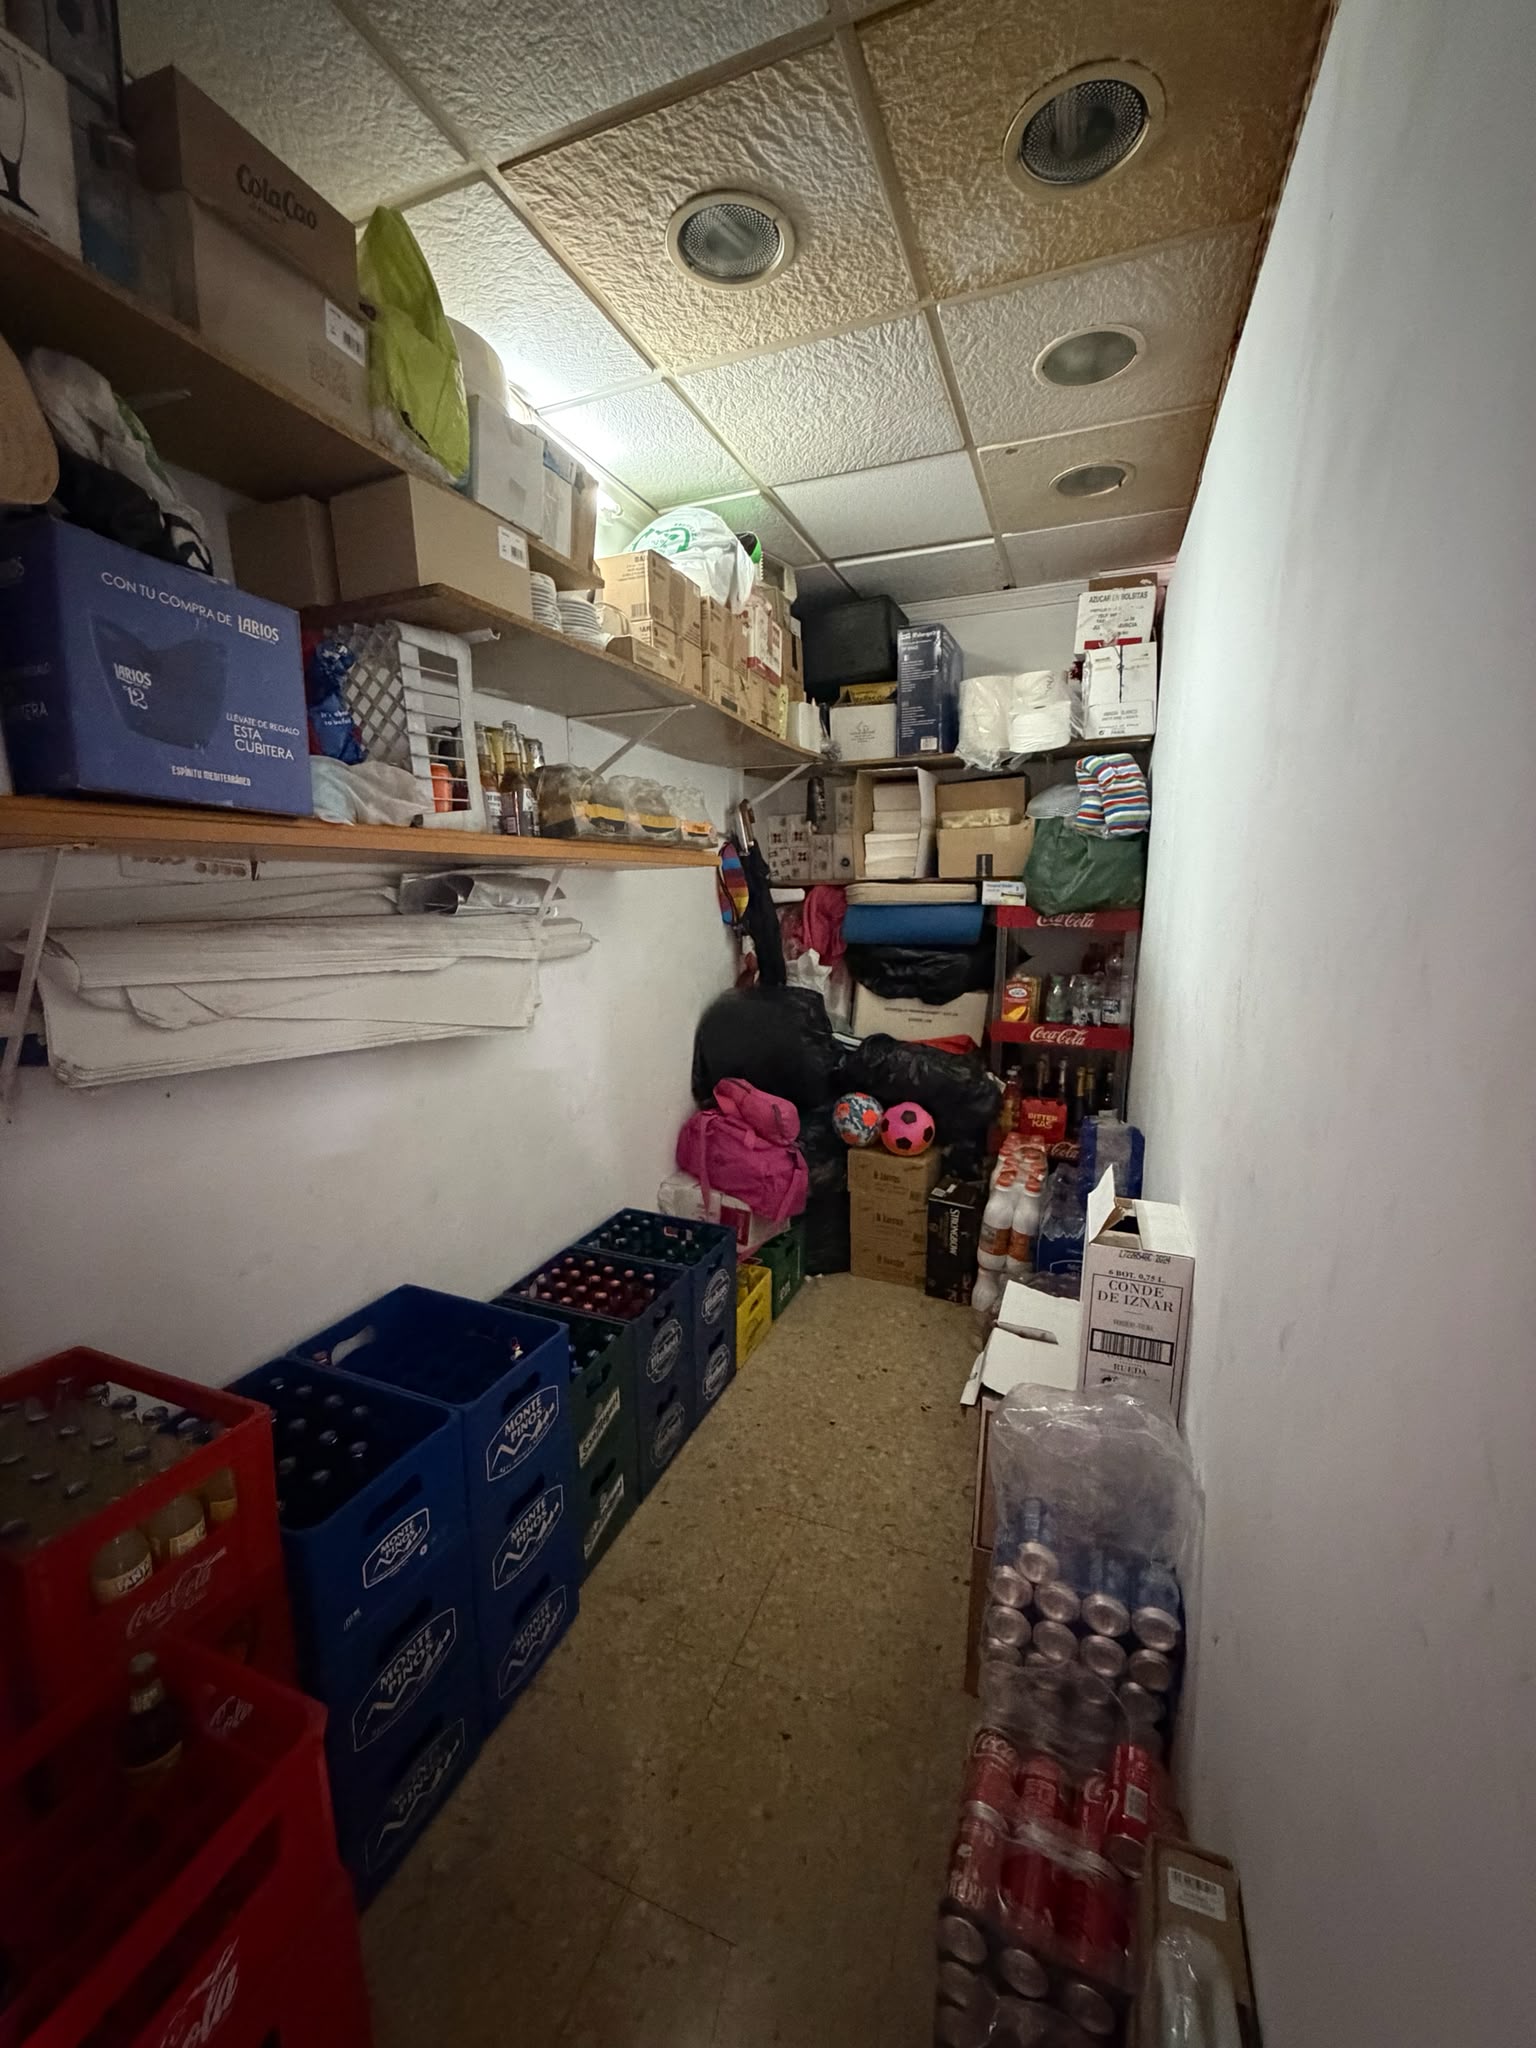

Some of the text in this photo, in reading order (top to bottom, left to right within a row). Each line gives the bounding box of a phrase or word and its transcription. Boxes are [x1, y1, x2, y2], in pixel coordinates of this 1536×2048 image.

[100, 570, 280, 643] CON TU COMPRA DE LARIOS
[113, 662, 153, 688] LARIOS
[233, 724, 262, 741] ESTA
[257, 719, 269, 730] DE
[269, 722, 300, 736] REGALO
[234, 739, 295, 761] CUBITERA
[1097, 1290, 1174, 1313] DE IZNAR
[1108, 1279, 1165, 1298] CONDE
[1113, 1362, 1148, 1376] RUEDA
[504, 1393, 542, 1438] MONTE
[510, 1406, 547, 1443] PINOS
[510, 1496, 547, 1545] MONTE
[516, 1509, 549, 1549] PINOS
[379, 1519, 417, 1557] MONTE
[384, 1529, 417, 1560] PINOS
[379, 1626, 433, 1692] MONTE
[388, 1638, 435, 1697] PINOS
